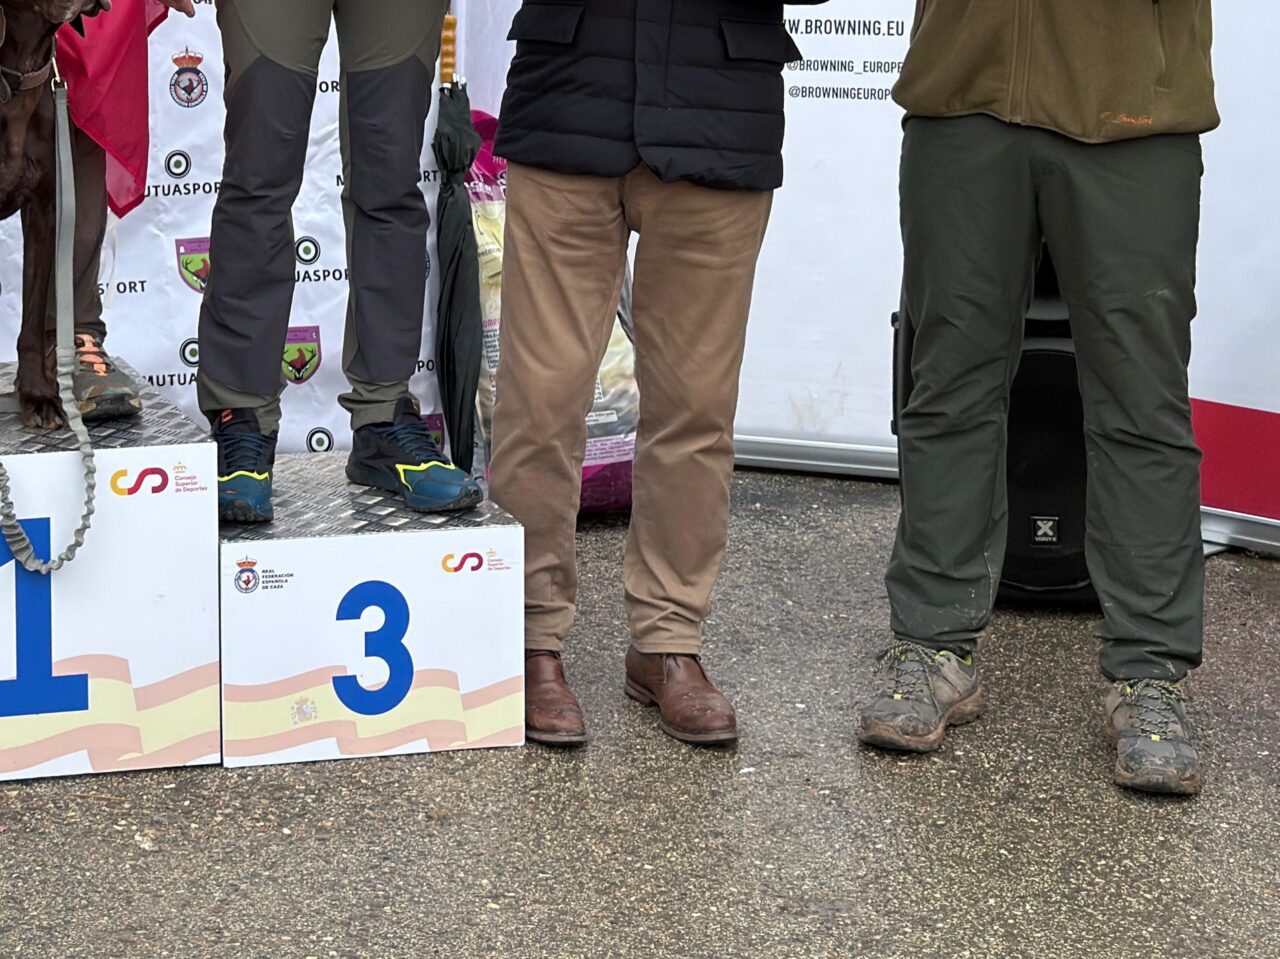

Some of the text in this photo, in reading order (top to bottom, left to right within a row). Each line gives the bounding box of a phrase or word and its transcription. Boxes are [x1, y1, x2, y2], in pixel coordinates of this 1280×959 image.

[783, 19, 905, 36] W.BROWNING.EU
[789, 86, 891, 101] @BROWNINGEUROP
[332, 580, 414, 716] 3
